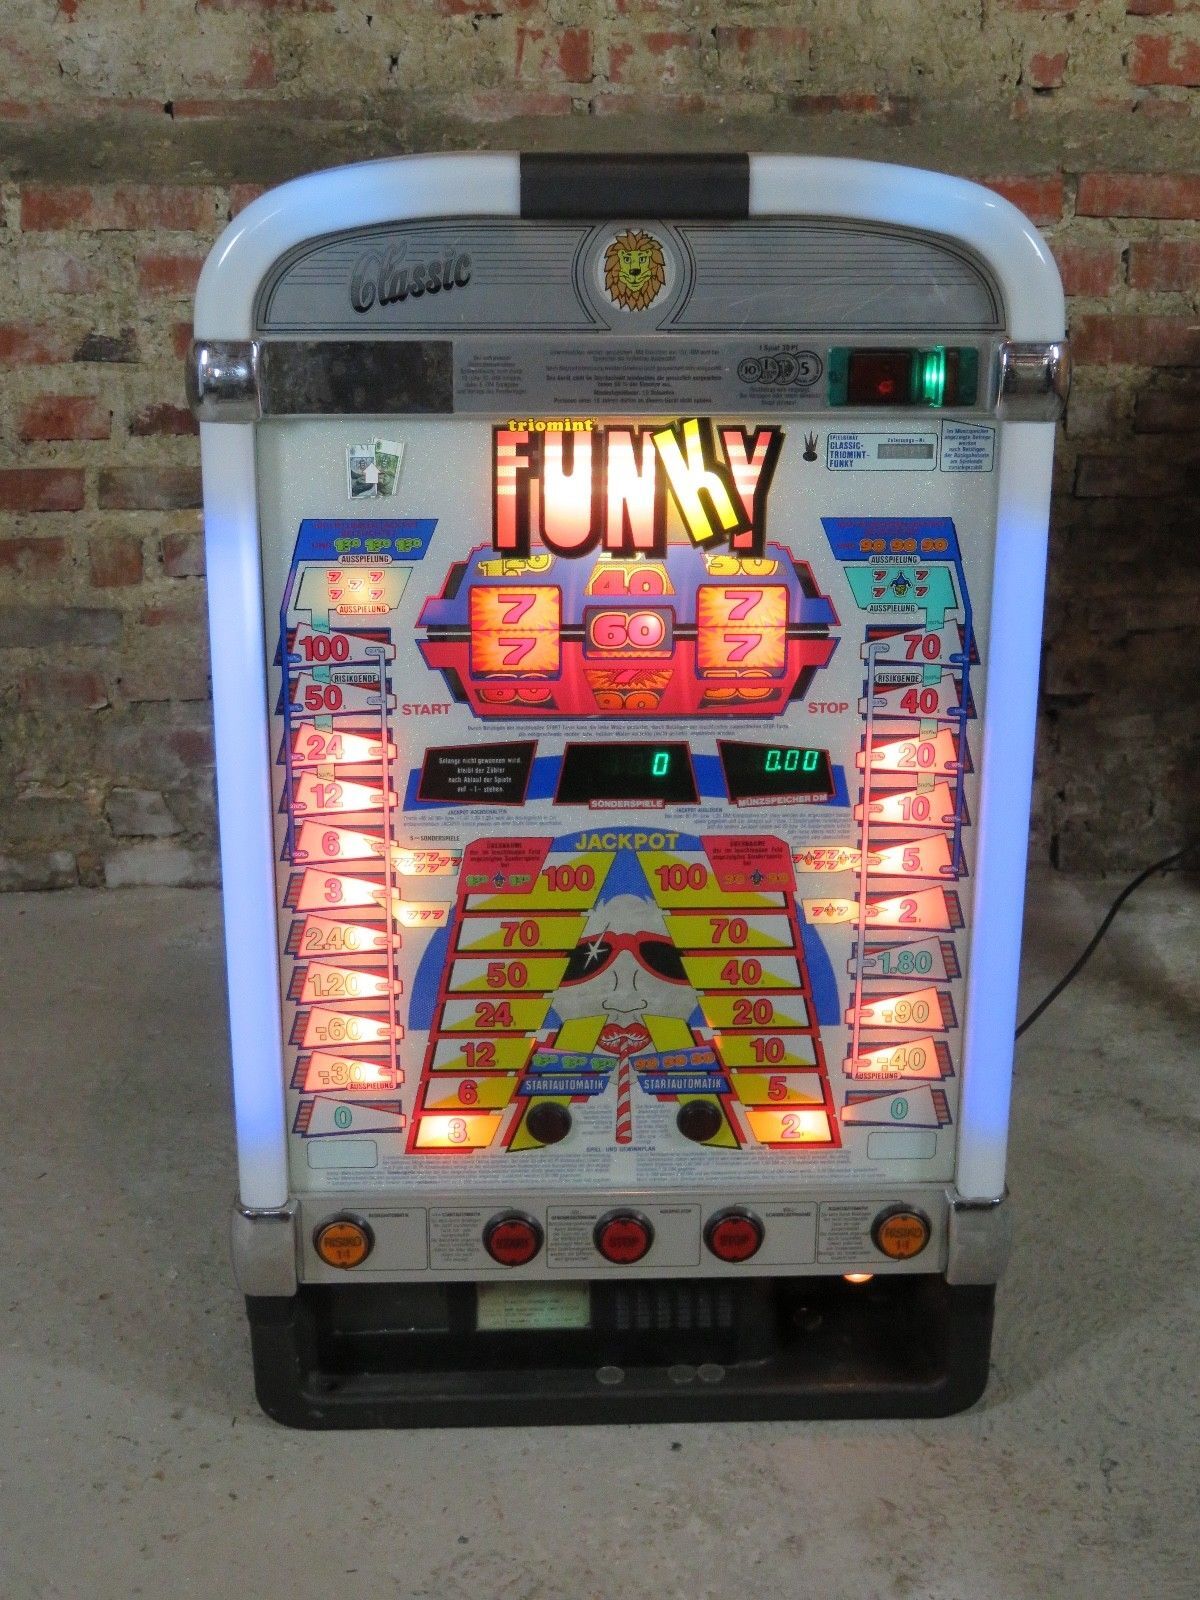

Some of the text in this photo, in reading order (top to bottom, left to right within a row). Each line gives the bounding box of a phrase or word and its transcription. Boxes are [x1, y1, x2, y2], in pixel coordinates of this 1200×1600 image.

[349, 239, 473, 315] Classic
[507, 418, 595, 432] triomint
[830, 442, 864, 450] CLASSIC-
[829, 460, 854, 468] FUNKY
[491, 417, 786, 560] FUNKY
[341, 555, 389, 563] AUSSPIELUNG
[339, 605, 387, 613] AUSSPIELUNG
[498, 594, 536, 624] 7
[724, 590, 763, 621] 7
[869, 604, 916, 613] AUSSPIELUNG
[592, 613, 664, 647] 60
[299, 635, 350, 661] 100
[498, 638, 536, 665] 7
[723, 634, 763, 661] 7
[904, 633, 942, 660] 70
[334, 674, 377, 683] RISIKOENDE
[877, 674, 920, 683] RISIKOENDE
[304, 684, 343, 711] 50
[402, 703, 452, 716] START
[808, 702, 850, 715] STOP
[900, 687, 939, 714] 40
[307, 735, 344, 760] 24
[897, 742, 935, 768] 20
[652, 753, 669, 776] 0
[765, 750, 819, 772] 0.00
[310, 783, 344, 809] 12
[591, 800, 662, 808] SONDERSPIELE
[897, 796, 931, 821] 10
[321, 831, 341, 857] 6
[575, 832, 680, 851] JACKPOT
[901, 847, 921, 872] 5
[542, 864, 596, 892] 100
[655, 862, 708, 892] 100
[324, 878, 343, 903] 3
[899, 899, 918, 923] 2
[305, 926, 362, 951] 2.40
[500, 919, 540, 948] 70
[709, 917, 748, 944] 70
[486, 961, 528, 988] 50
[720, 958, 762, 986] 40
[877, 950, 933, 975] 1.80
[308, 972, 362, 997] 1.20
[474, 1001, 514, 1028] 24
[732, 998, 774, 1026] 20
[460, 1041, 497, 1068] 12
[750, 1037, 785, 1064] 10
[349, 1082, 394, 1090] AUSSPIELUNG
[526, 1079, 604, 1091] STARTAUTOMATIK
[643, 1078, 722, 1090] STARTAUTOMATIK
[768, 1075, 788, 1101] 5
[854, 1072, 899, 1080] AUSSPIELUNG
[457, 1079, 478, 1105] 6
[334, 1105, 353, 1129] 0
[890, 1097, 909, 1121] 0
[447, 1118, 468, 1144] 3
[780, 1113, 801, 1139] 2
